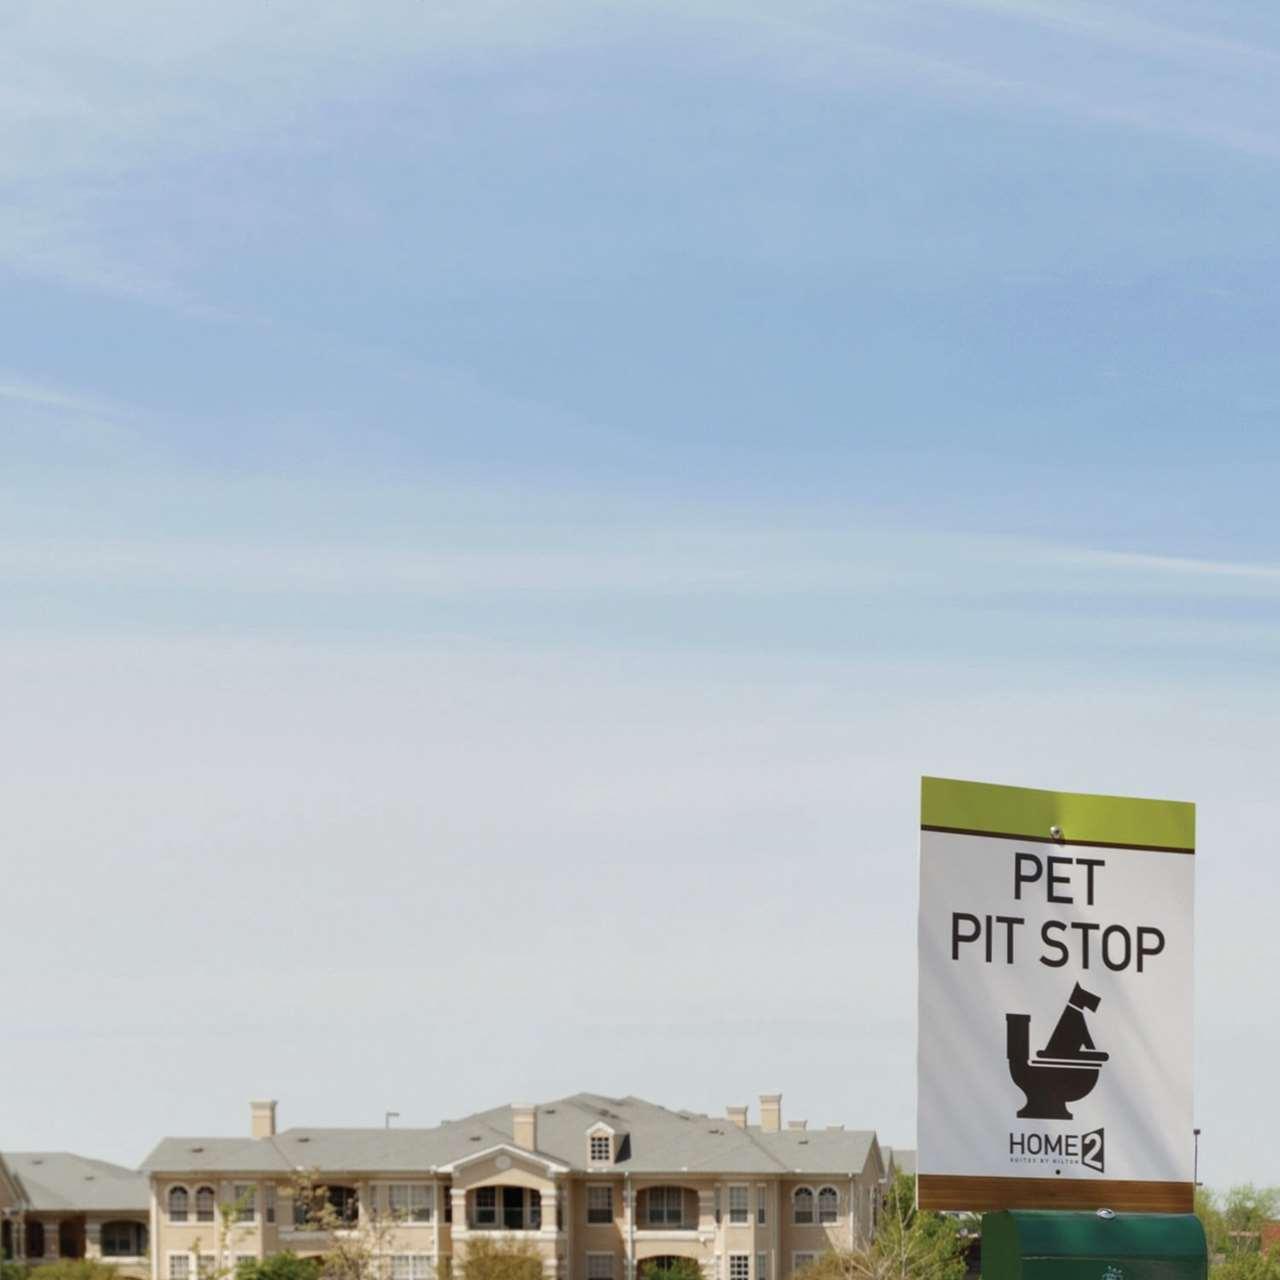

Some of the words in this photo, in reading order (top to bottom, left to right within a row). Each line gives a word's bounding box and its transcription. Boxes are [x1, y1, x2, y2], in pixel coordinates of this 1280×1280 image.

[1014, 852, 1106, 906] PET
[951, 911, 1025, 965] PIT
[1039, 920, 1166, 974] STOP
